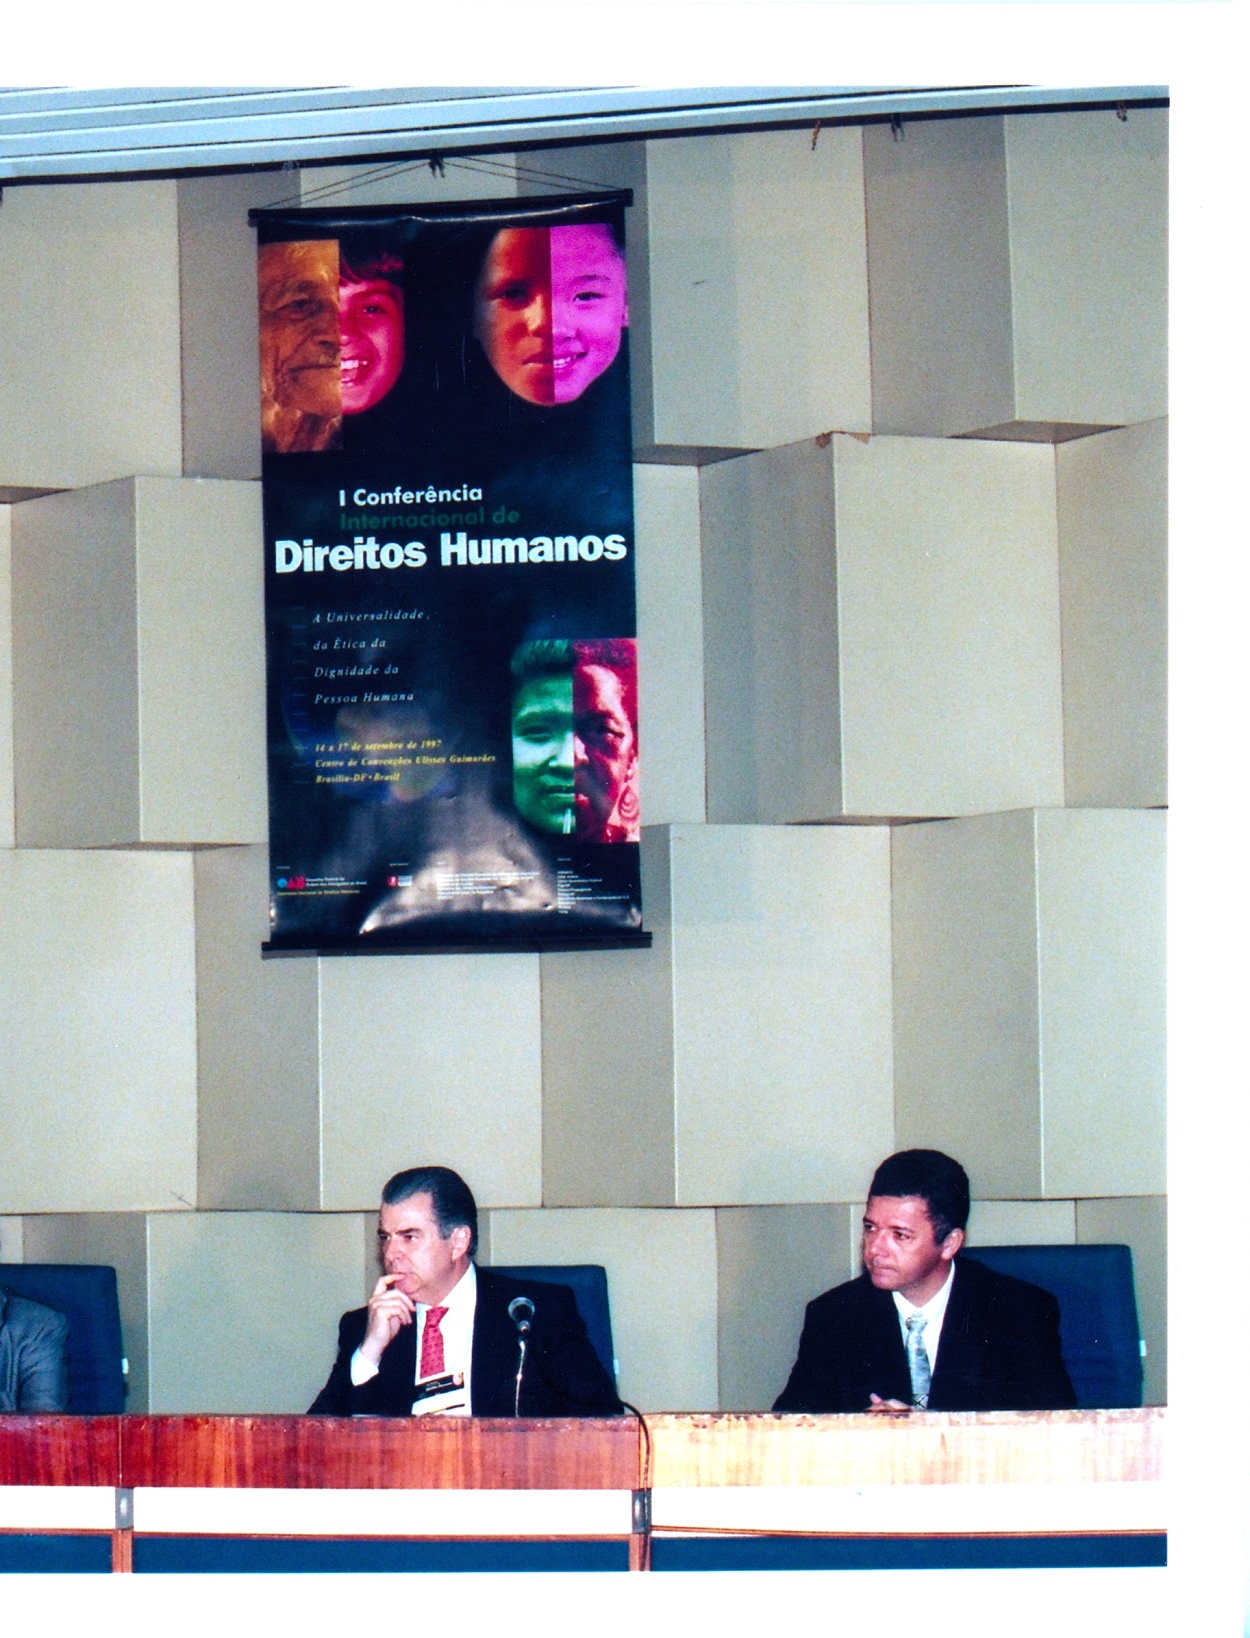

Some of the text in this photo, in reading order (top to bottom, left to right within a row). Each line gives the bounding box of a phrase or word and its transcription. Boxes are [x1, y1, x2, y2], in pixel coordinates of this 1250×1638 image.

[339, 483, 484, 507] I Conferência
[340, 506, 521, 531] Internacional de
[275, 532, 628, 574] Direitos Humanos
[313, 610, 425, 623] A Universalidade
[313, 637, 387, 650] da Ética da
[314, 664, 399, 679] Dignidade da
[314, 690, 414, 705] Pessoa Humana
[315, 744, 326, 753] 14
[351, 742, 362, 751] de
[364, 741, 405, 751] setembro
[406, 741, 418, 750] de
[421, 739, 443, 749] 1997
[315, 759, 345, 768] Centro
[347, 758, 358, 767] de
[361, 756, 412, 768] Convenções
[449, 754, 497, 764] Guimarães
